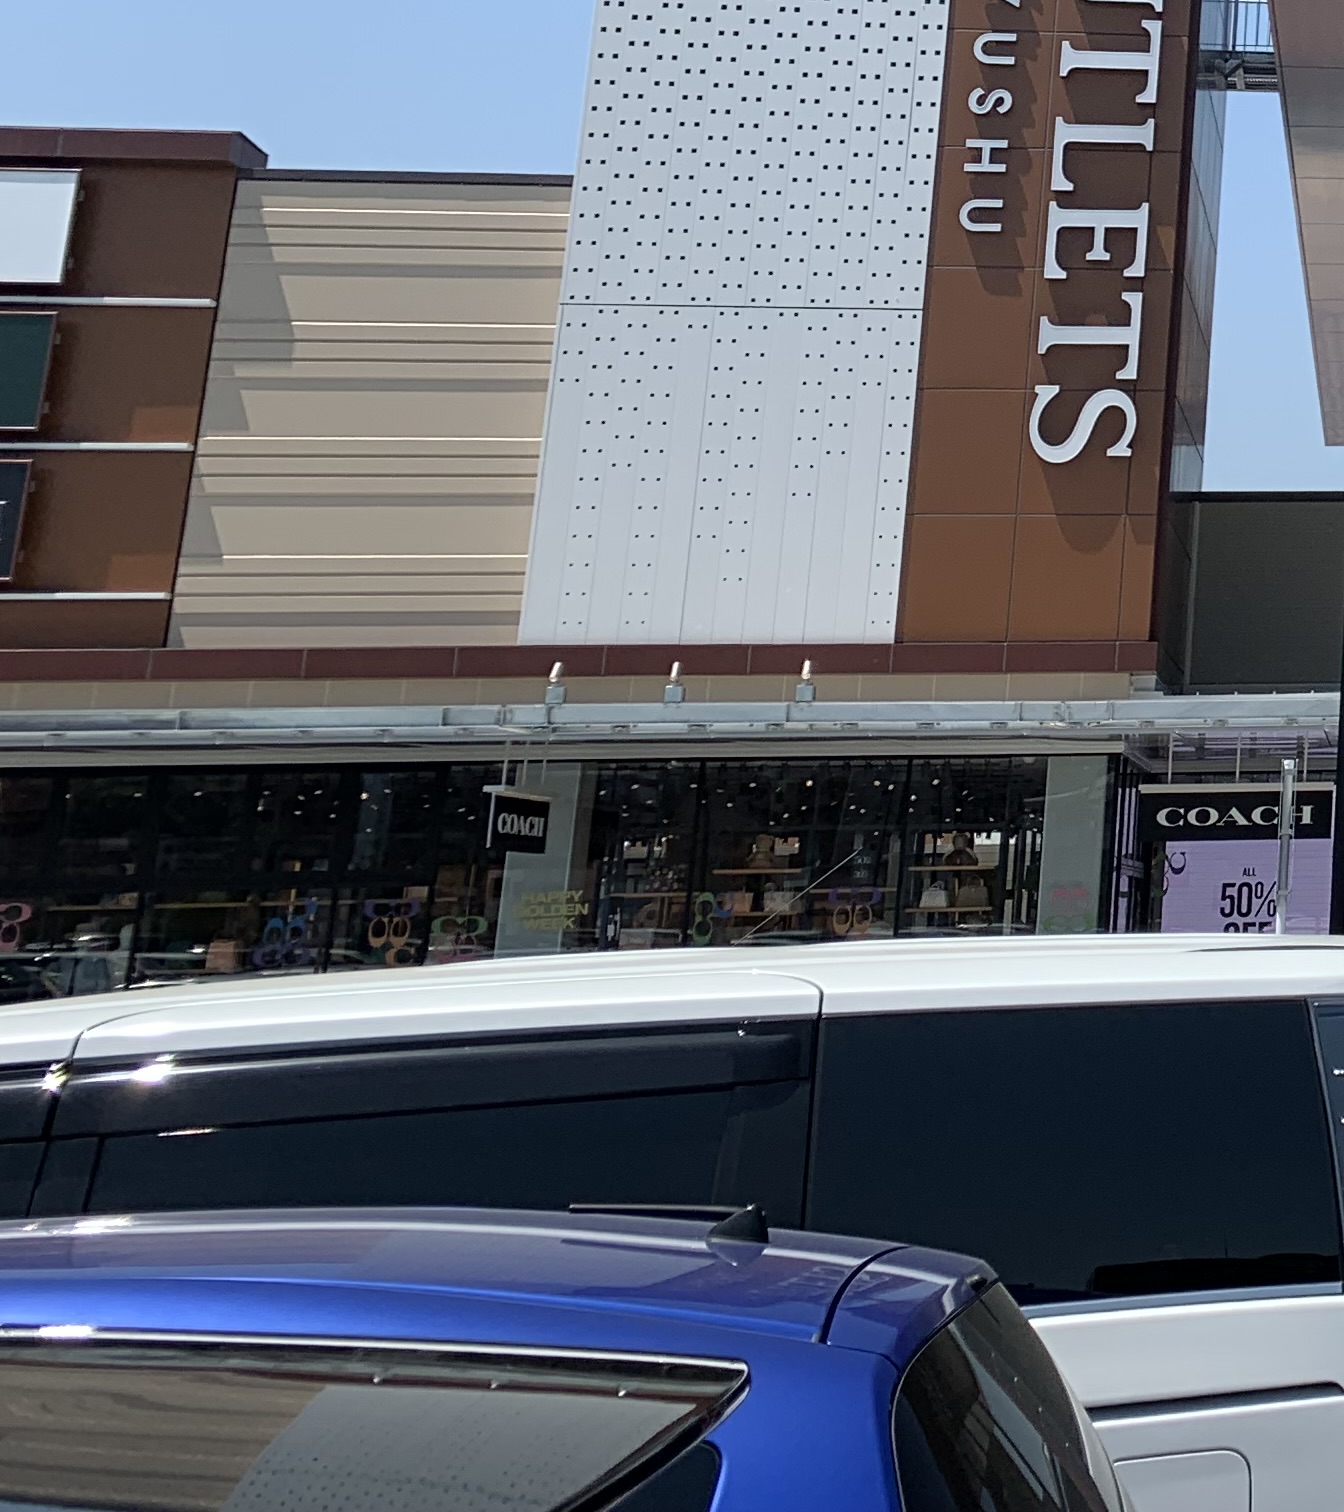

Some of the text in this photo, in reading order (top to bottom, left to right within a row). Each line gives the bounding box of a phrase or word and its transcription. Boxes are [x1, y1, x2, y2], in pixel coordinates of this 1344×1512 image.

[497, 812, 545, 837] COACH
[1155, 805, 1315, 828] COACH
[1242, 867, 1257, 878] ALL
[1220, 881, 1277, 919] 50%
[523, 917, 576, 931] WEEK
